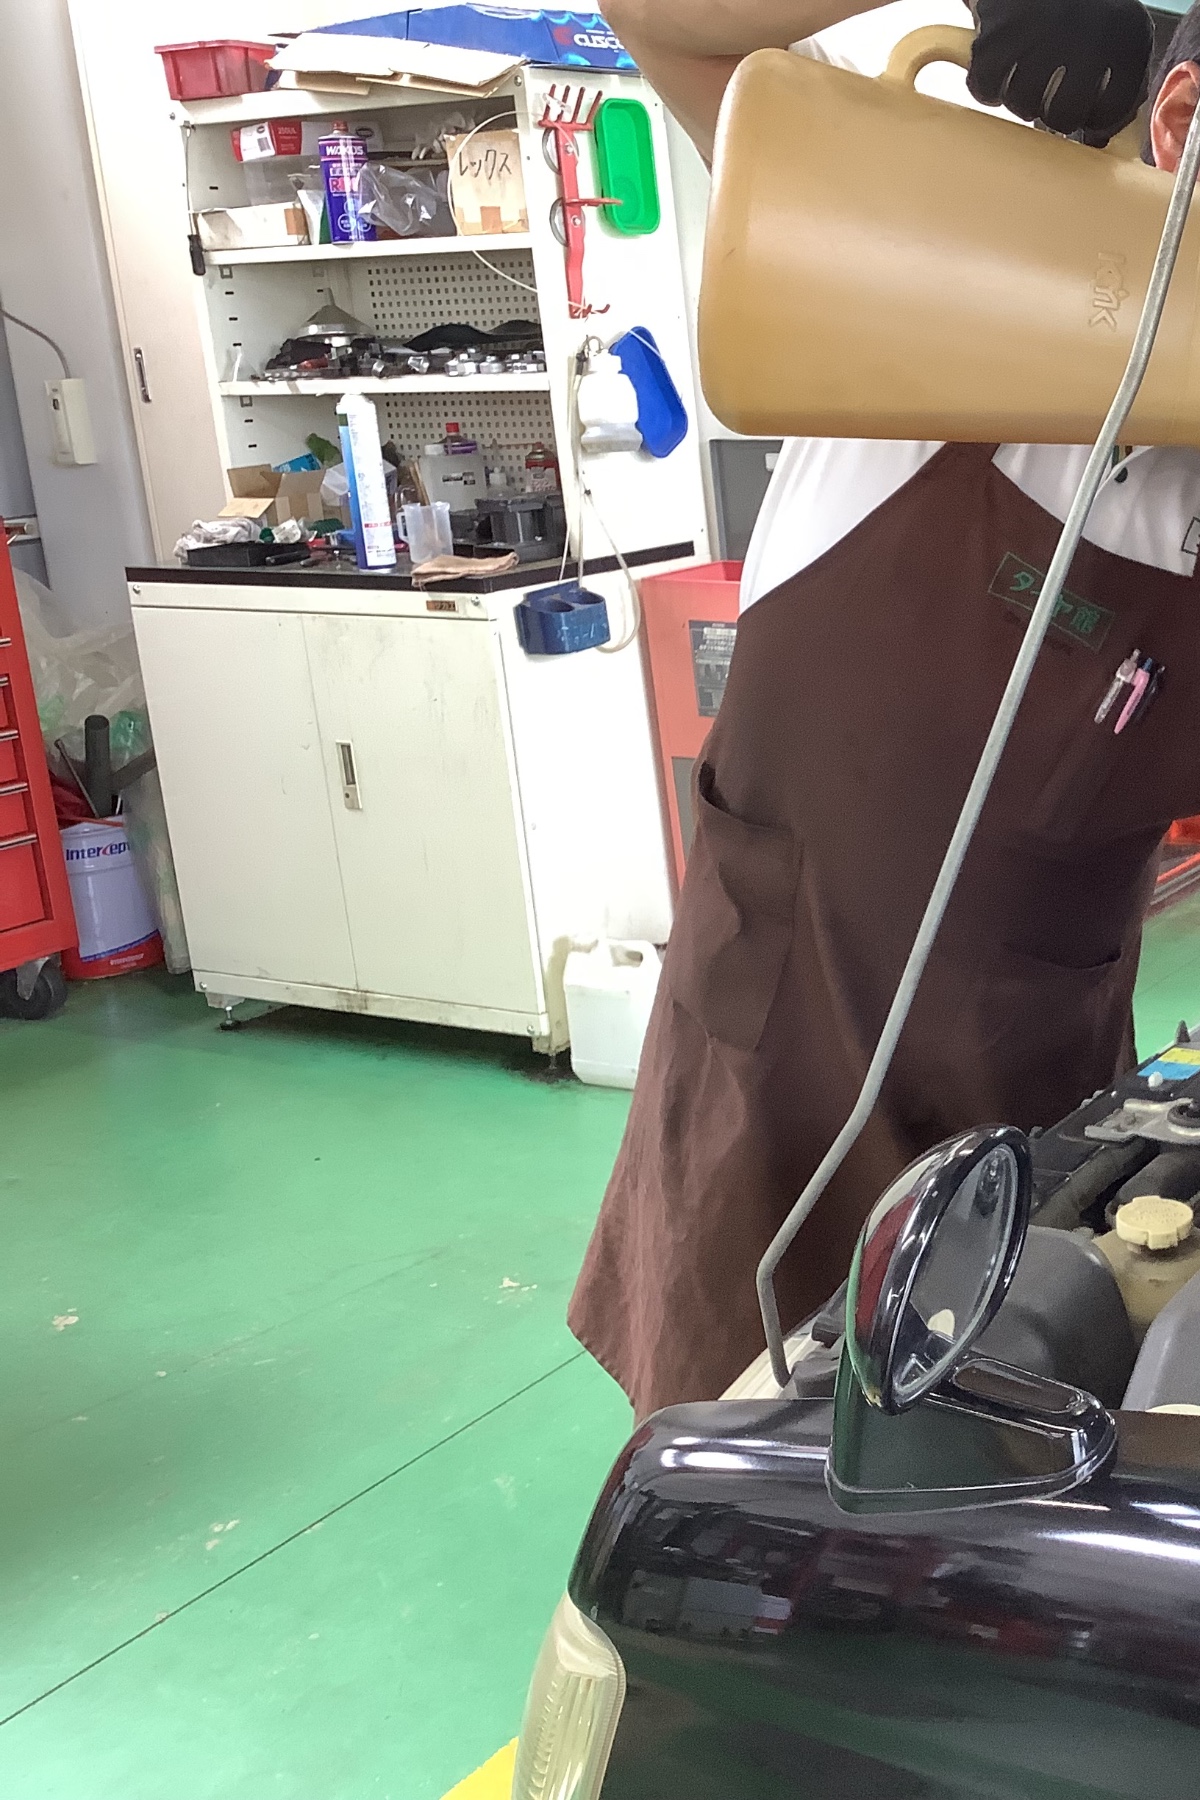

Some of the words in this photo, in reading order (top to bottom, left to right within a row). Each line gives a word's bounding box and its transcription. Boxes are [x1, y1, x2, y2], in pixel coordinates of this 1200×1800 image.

[457, 149, 512, 180] レックス
[1008, 571, 1101, 635] タヤ館
